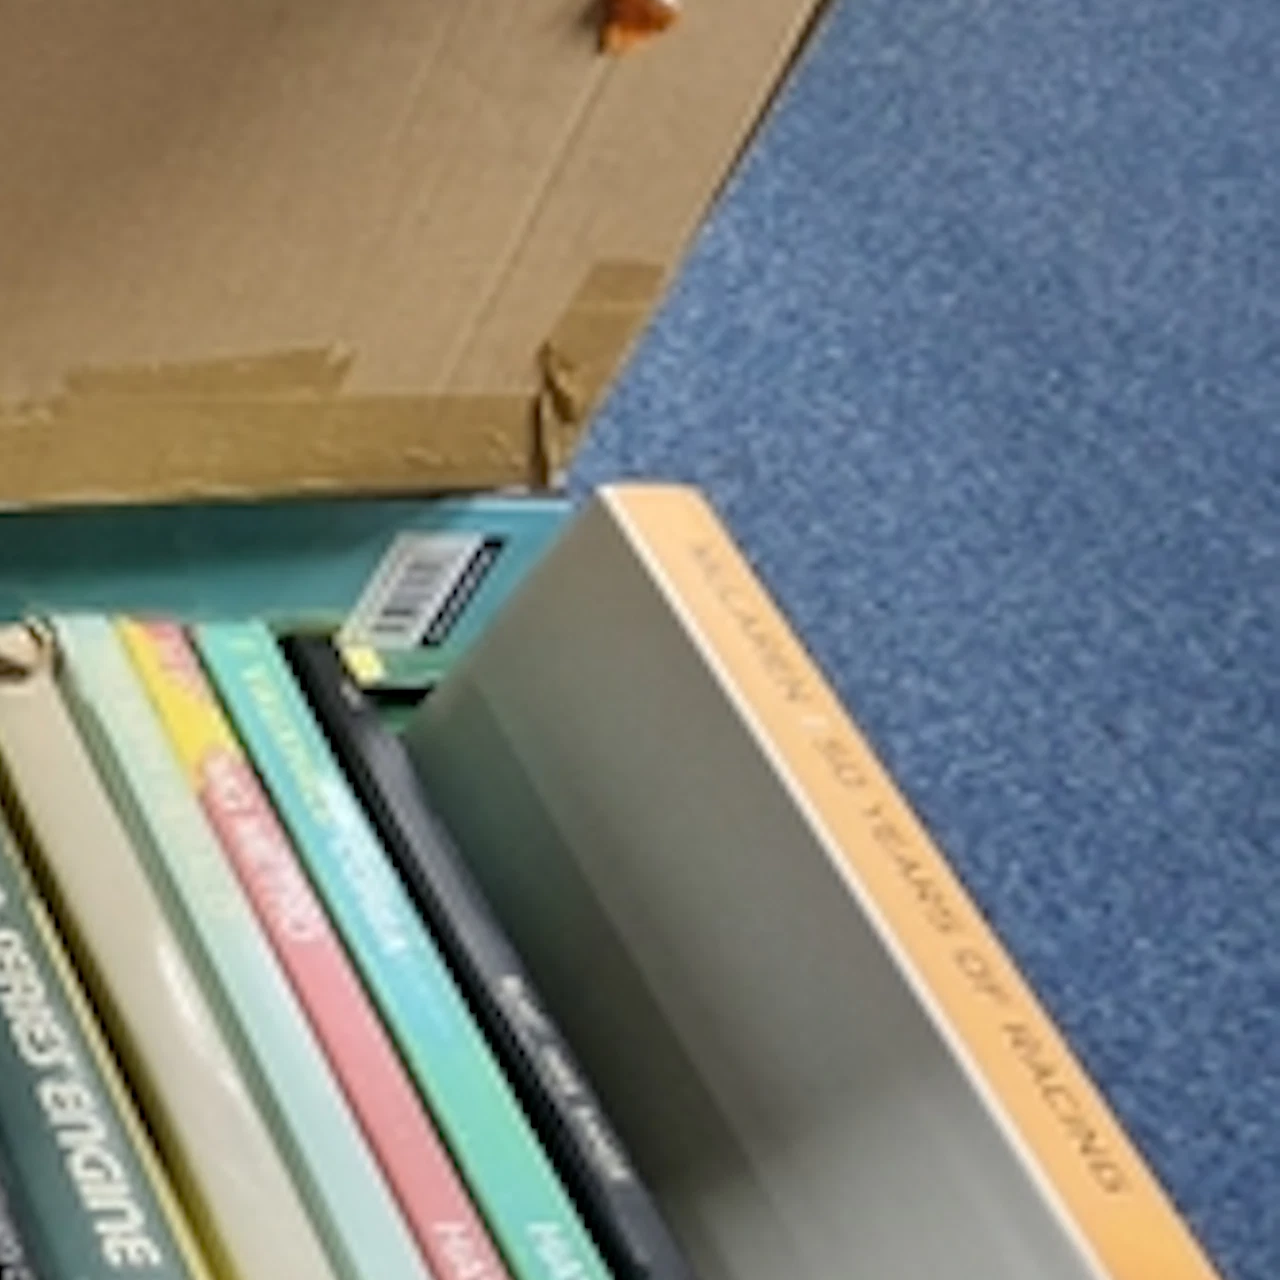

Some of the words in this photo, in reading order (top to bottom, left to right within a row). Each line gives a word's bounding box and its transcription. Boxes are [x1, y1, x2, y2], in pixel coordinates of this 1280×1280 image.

[811, 729, 869, 797] 50
[857, 799, 961, 938] YEARS
[951, 941, 1009, 1010] OF
[997, 1013, 1135, 1202] RACING
